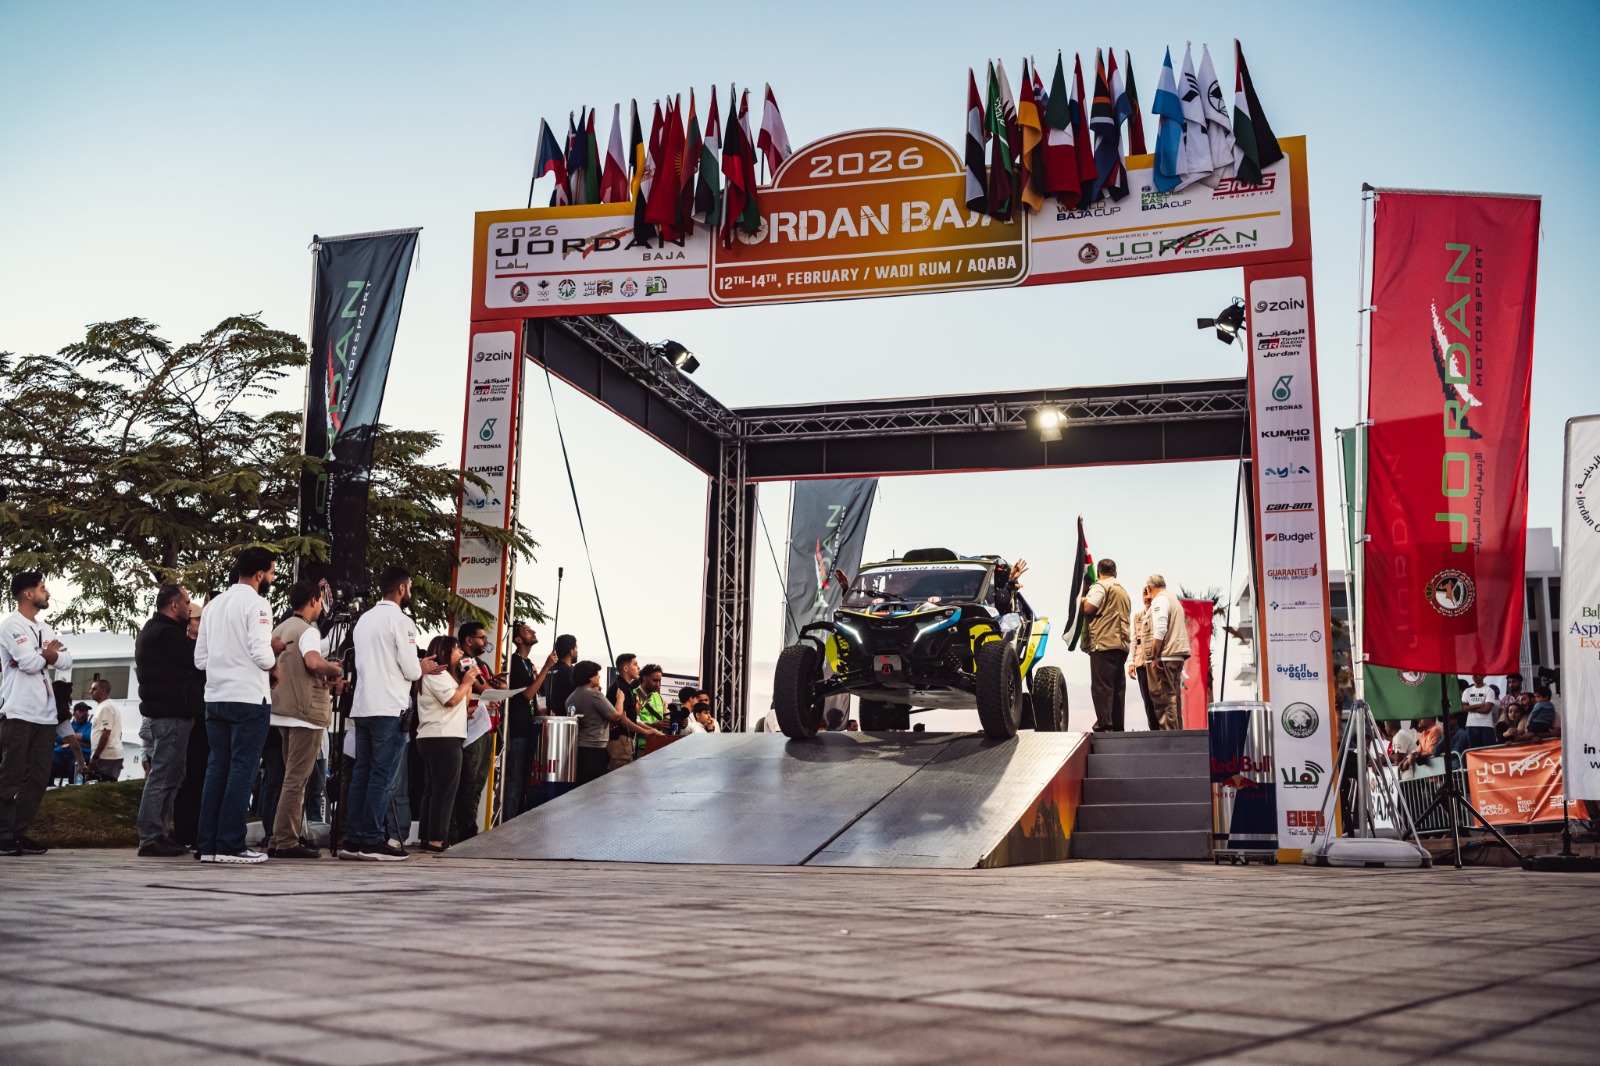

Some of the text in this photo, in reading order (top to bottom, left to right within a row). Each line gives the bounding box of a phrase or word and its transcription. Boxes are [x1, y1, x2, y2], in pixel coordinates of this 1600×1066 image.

[809, 146, 924, 178] 2026
[1056, 200, 1107, 213] WLD
[1141, 196, 1168, 205] EAST
[1141, 199, 1192, 212] BAJA CUP
[1056, 206, 1121, 222] BAJA CUP
[495, 225, 559, 239] 2026
[1106, 232, 1148, 241] POWERED
[1105, 229, 1258, 258] JORDAN
[1184, 242, 1258, 255] MOTORSPORT
[642, 250, 686, 262] BAJA
[786, 267, 860, 286] FEBRUARY
[863, 266, 870, 280] /
[875, 263, 914, 280] WADI
[919, 260, 951, 276] RUM
[956, 259, 963, 273] /
[967, 255, 1017, 273] AQABA
[1475, 245, 1483, 387] MOTORSPORT
[1263, 350, 1300, 358] Jordan
[1435, 243, 1471, 552] JORDAN
[1265, 404, 1303, 412] PETRONAS
[1261, 429, 1310, 438] KUMHO
[467, 465, 505, 473] KUMHO
[1265, 502, 1313, 511] can-am
[1576, 496, 1595, 526] Jordan
[1278, 532, 1315, 543] Budget
[470, 557, 499, 566] Budget
[1267, 568, 1309, 577] GUARANTEE
[1288, 669, 1319, 680] aqaba
[1584, 743, 1596, 755] in
[1240, 755, 1271, 773] Bull
